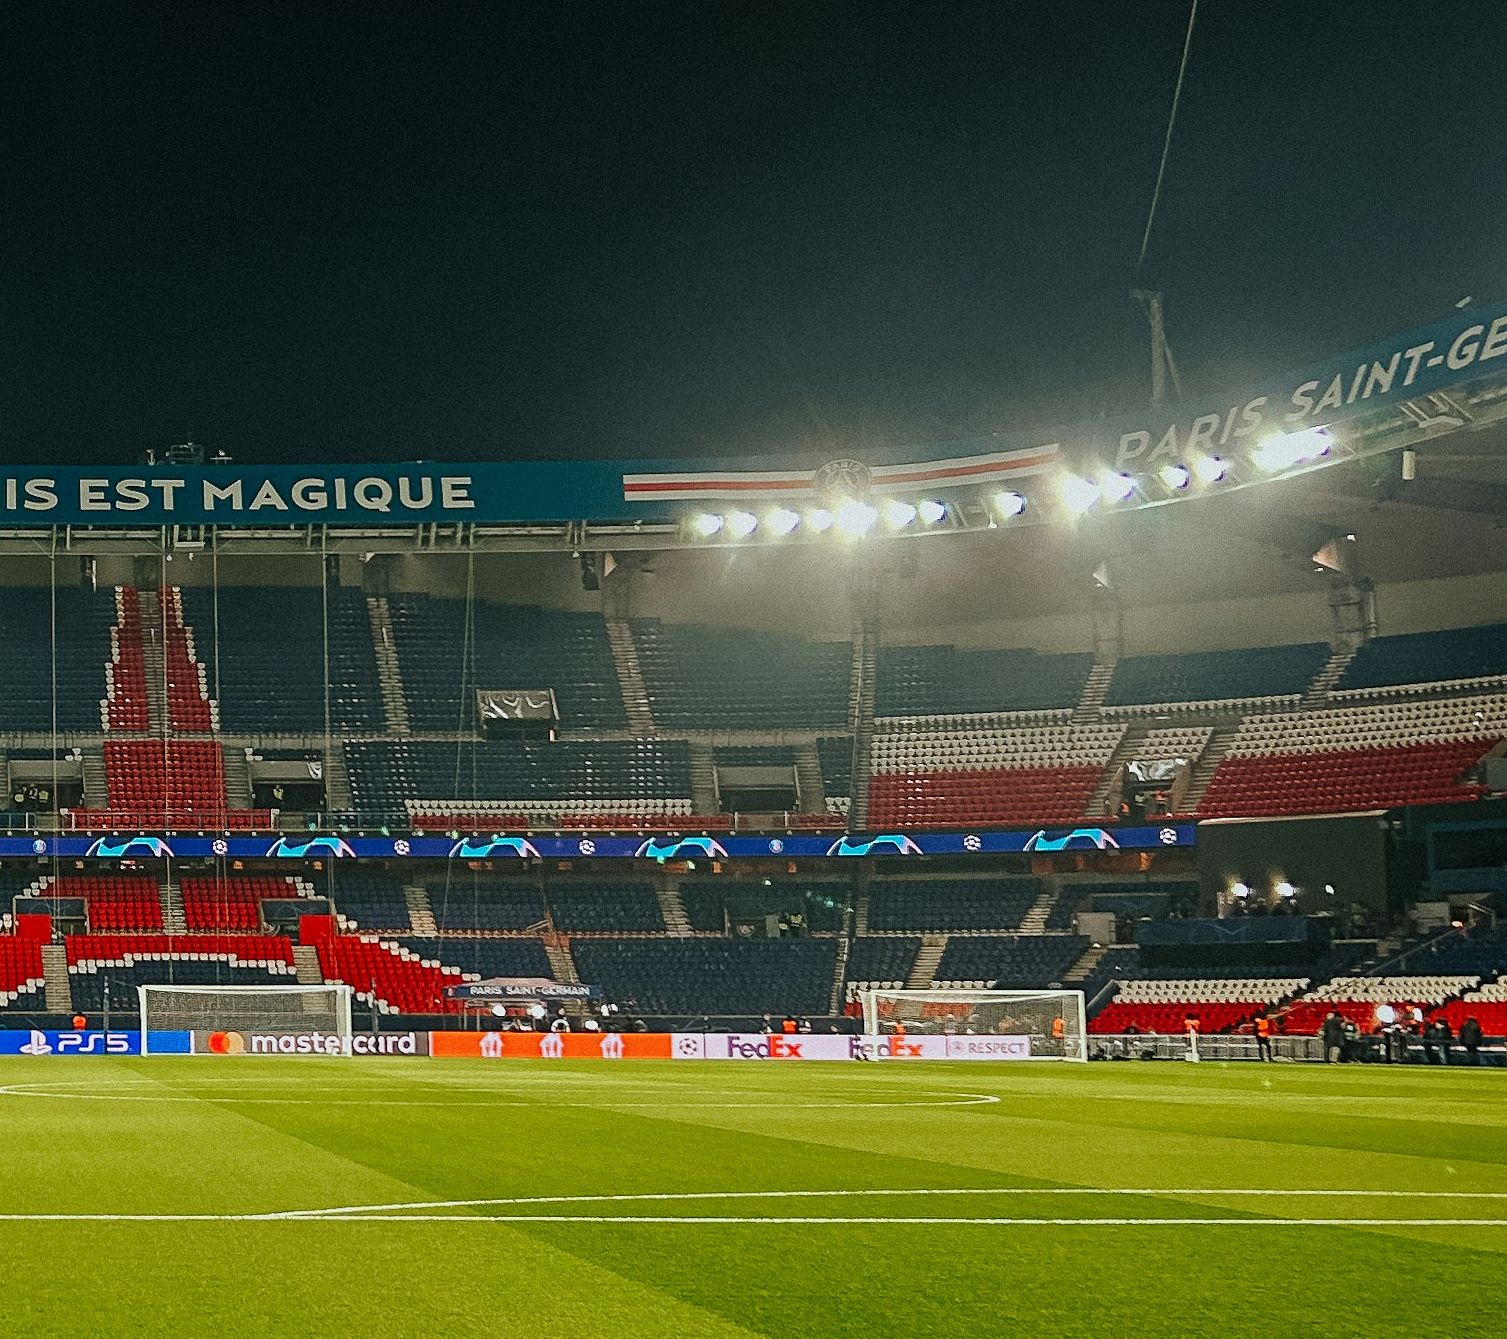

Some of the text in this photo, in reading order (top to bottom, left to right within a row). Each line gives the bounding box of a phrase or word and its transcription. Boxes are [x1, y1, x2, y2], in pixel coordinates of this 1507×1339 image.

[1114, 315, 1507, 467] PARIS SAINT-GE
[79, 478, 185, 511] EST
[202, 476, 475, 512] MAGIQUE
[470, 986, 590, 996] PARIS SAINT-GERMAIN
[57, 1033, 130, 1052] PS5
[251, 1031, 417, 1054] mastercard
[727, 1035, 803, 1058] FedEx
[968, 1042, 1025, 1054] RESPECT
